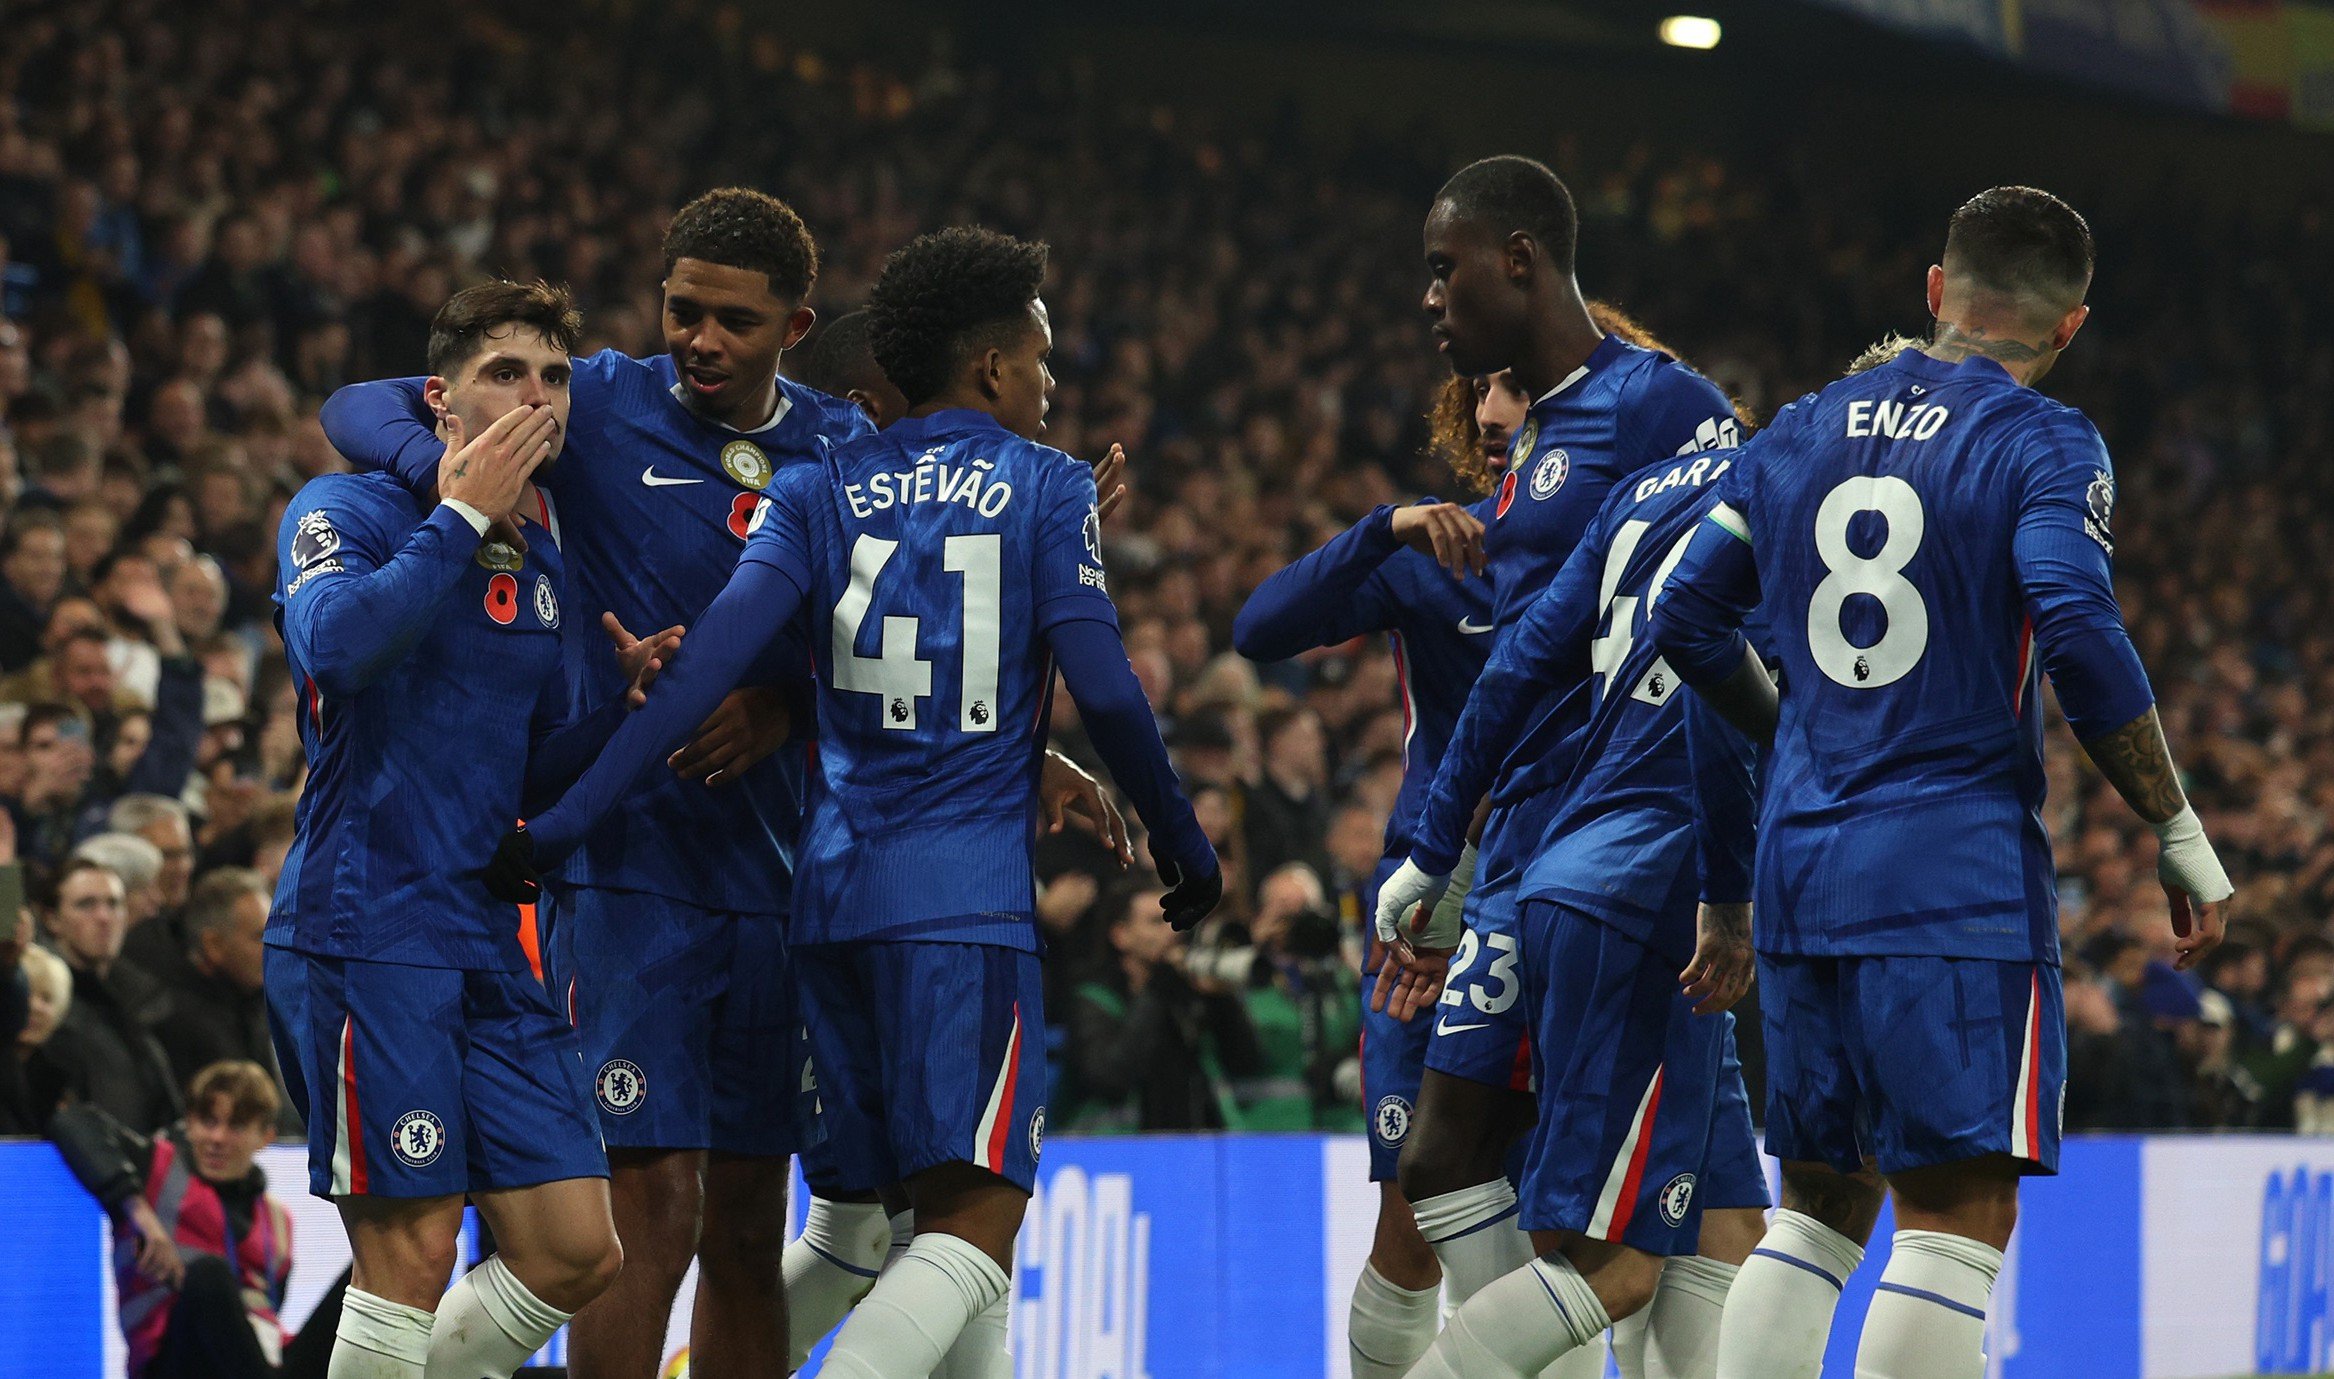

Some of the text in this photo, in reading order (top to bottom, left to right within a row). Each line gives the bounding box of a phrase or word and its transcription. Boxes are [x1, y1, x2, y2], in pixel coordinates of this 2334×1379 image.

[1846, 400, 1949, 441] ENZO
[735, 444, 768, 474] CHAMPIONS
[844, 454, 1013, 519] ESTÊVÃO
[1807, 475, 1929, 689] 8
[832, 532, 1002, 733] 41
[1440, 928, 1519, 1015] 23
[603, 1061, 636, 1074] CHELSEA
[400, 1112, 435, 1126] CHELSEA
